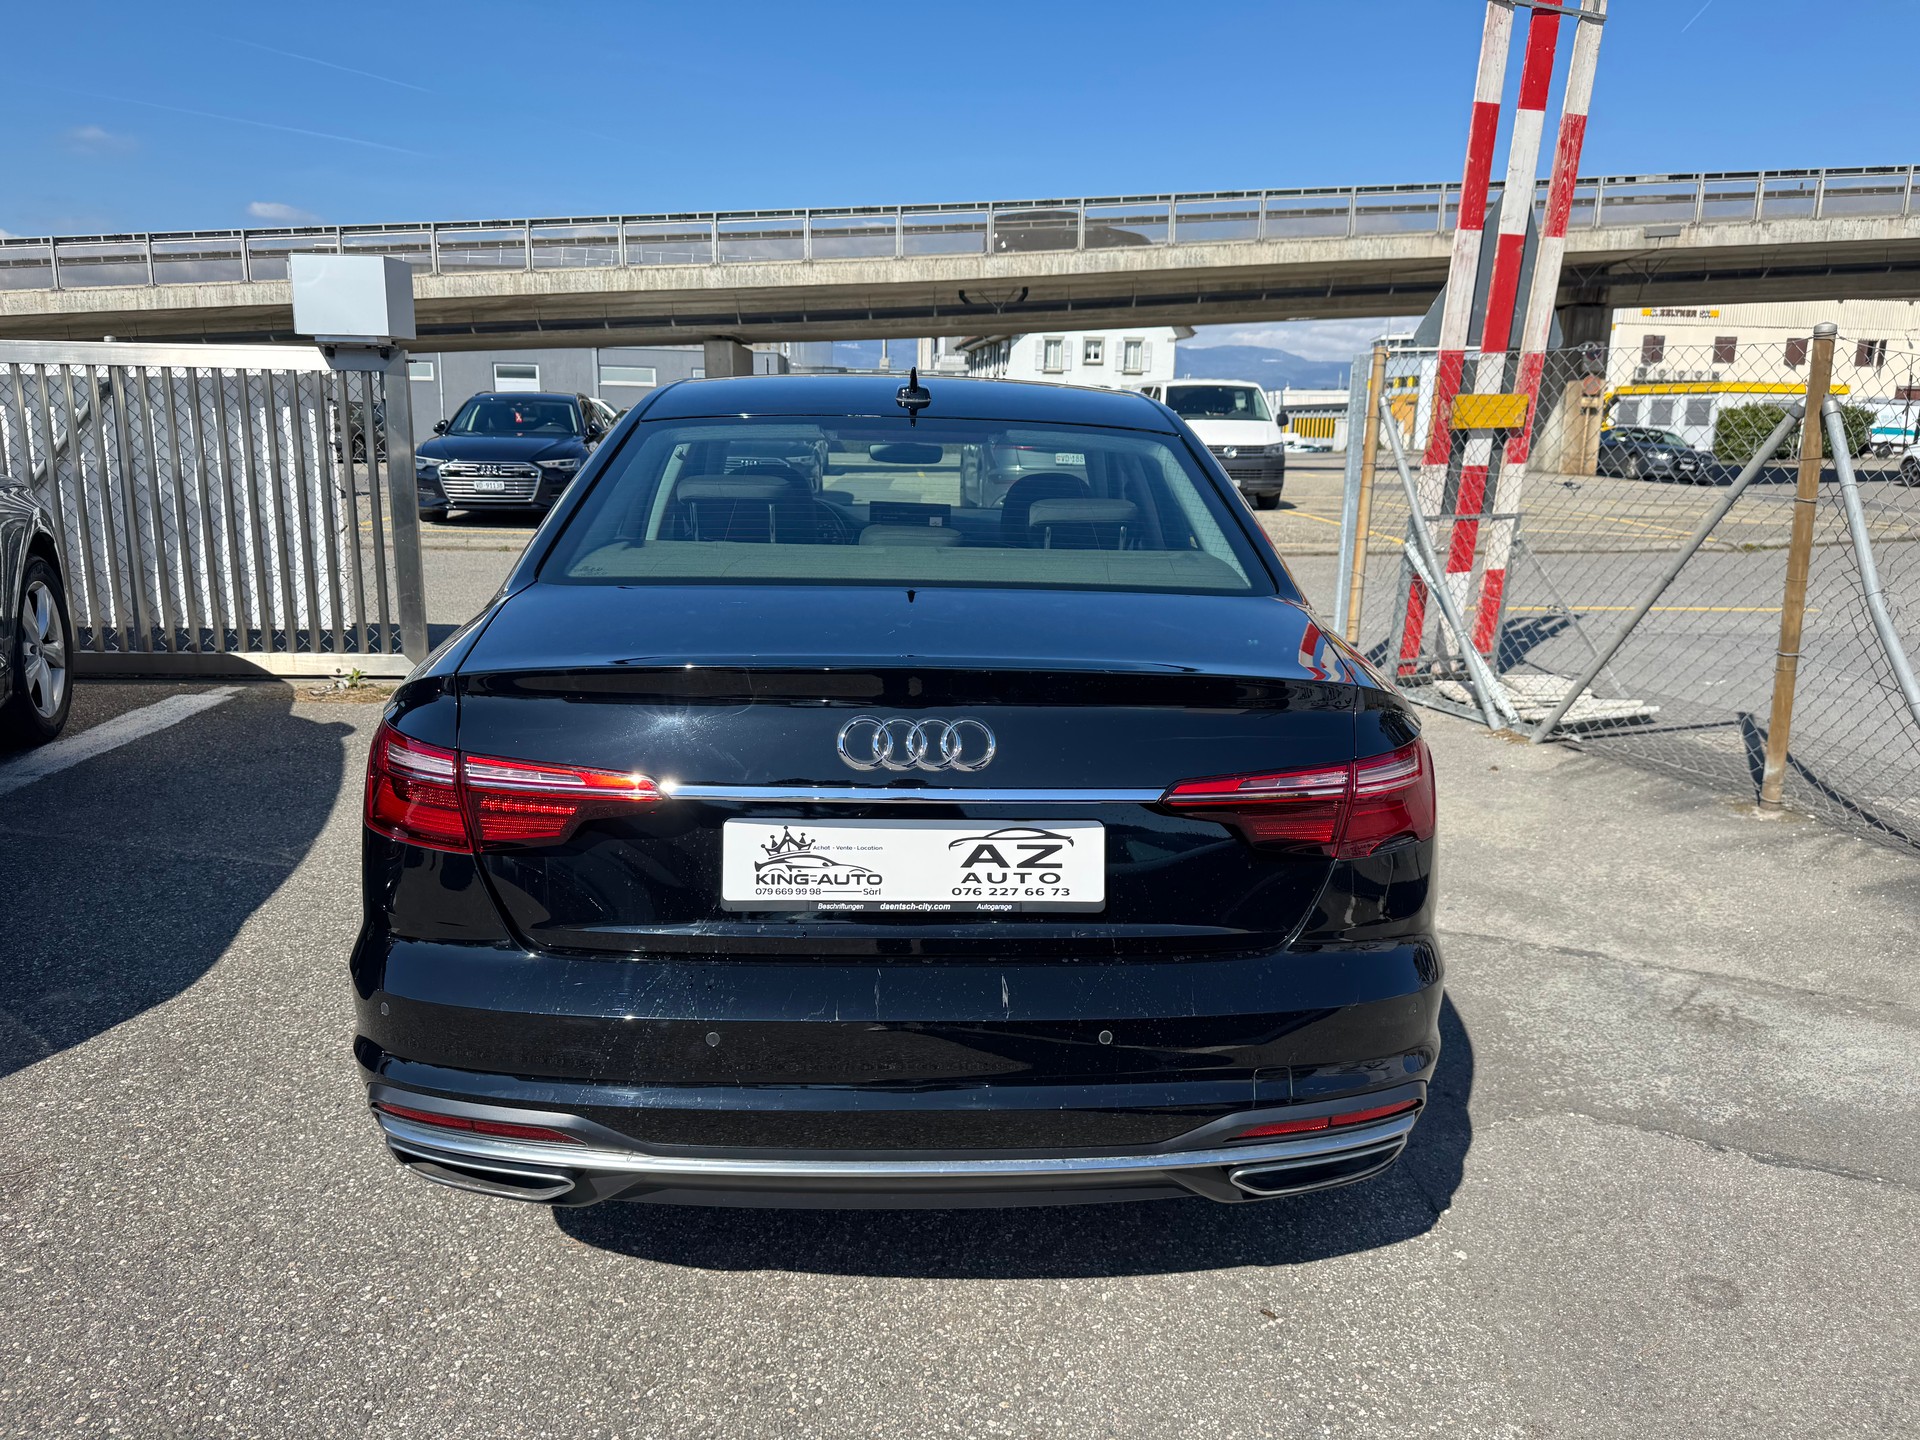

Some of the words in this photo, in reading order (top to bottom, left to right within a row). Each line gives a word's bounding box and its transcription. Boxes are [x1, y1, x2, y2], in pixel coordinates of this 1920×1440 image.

[960, 844, 1063, 868] AZ
[961, 872, 1061, 884] AUTO
[951, 887, 982, 896] 076
[988, 887, 1019, 896] 227
[1024, 887, 1045, 896] 66
[1051, 887, 1070, 896] 73
[880, 902, 951, 911] daentsch-city.com
[976, 903, 1012, 911] Autogarage
